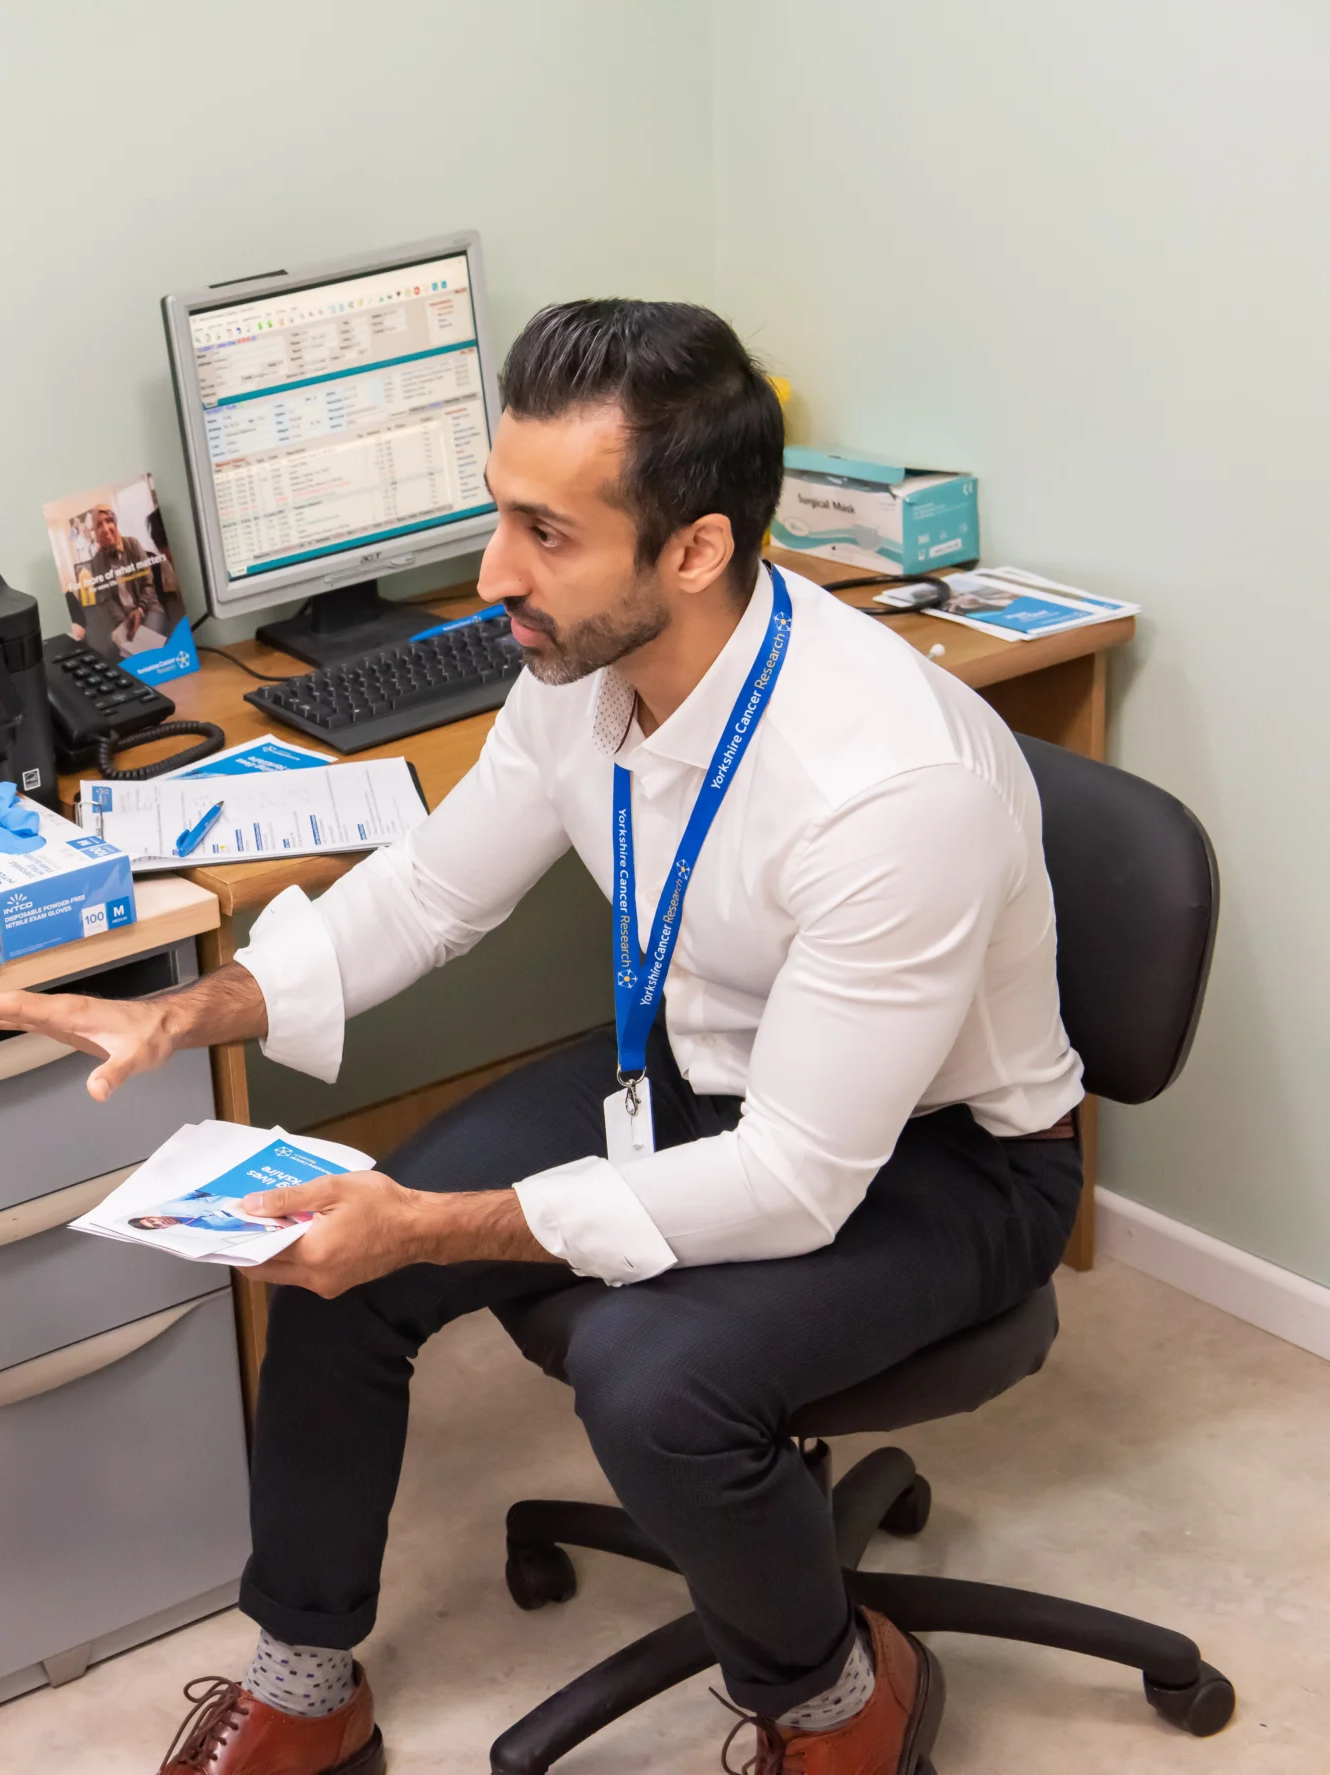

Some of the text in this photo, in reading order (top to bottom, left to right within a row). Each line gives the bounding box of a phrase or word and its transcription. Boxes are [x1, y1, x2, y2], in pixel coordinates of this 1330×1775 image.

[798, 494, 855, 514] Surgical Mask
[105, 570, 114, 580] of
[115, 563, 135, 576] what
[136, 554, 167, 569] matters
[711, 632, 785, 789] Yorkshire Cancer Research
[618, 808, 632, 968] Yorkshire Cancer Research
[4, 901, 33, 915] INTCO
[5, 895, 85, 923] DISPOSABLE POWDER-FREE
[6, 906, 72, 929] NITRILE EXAM GLOVES
[85, 912, 104, 925] 100
[113, 905, 124, 917] M
[640, 879, 683, 1006] Yorkshire Cancer Research
[246, 1169, 276, 1185] lives
[261, 1166, 302, 1186] kshire
